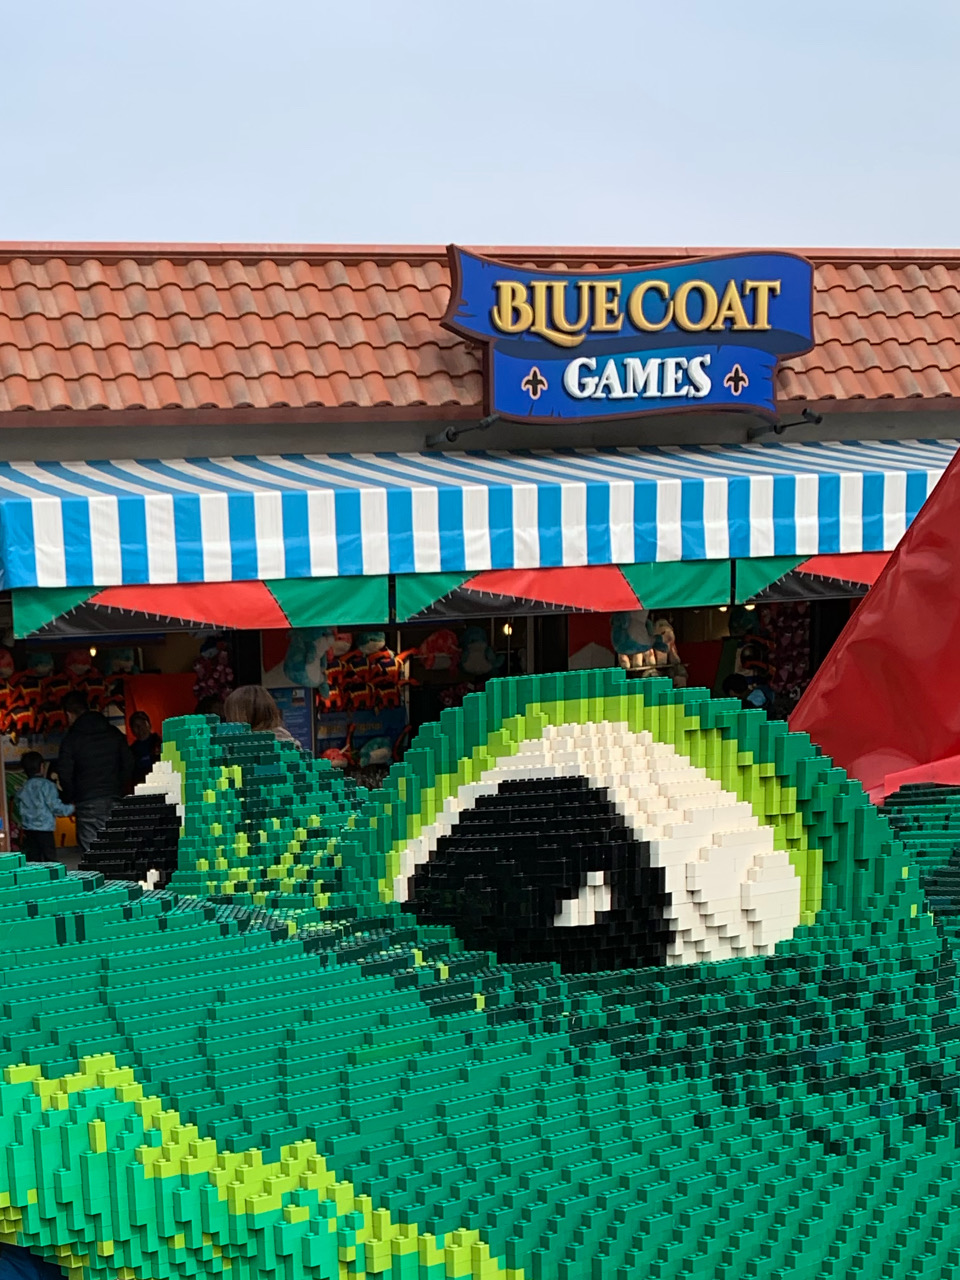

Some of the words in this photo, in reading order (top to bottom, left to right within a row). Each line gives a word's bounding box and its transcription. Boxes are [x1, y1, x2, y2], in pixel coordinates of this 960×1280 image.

[493, 279, 624, 348] BLUE
[628, 279, 781, 332] COAT
[563, 353, 713, 399] GAMES
